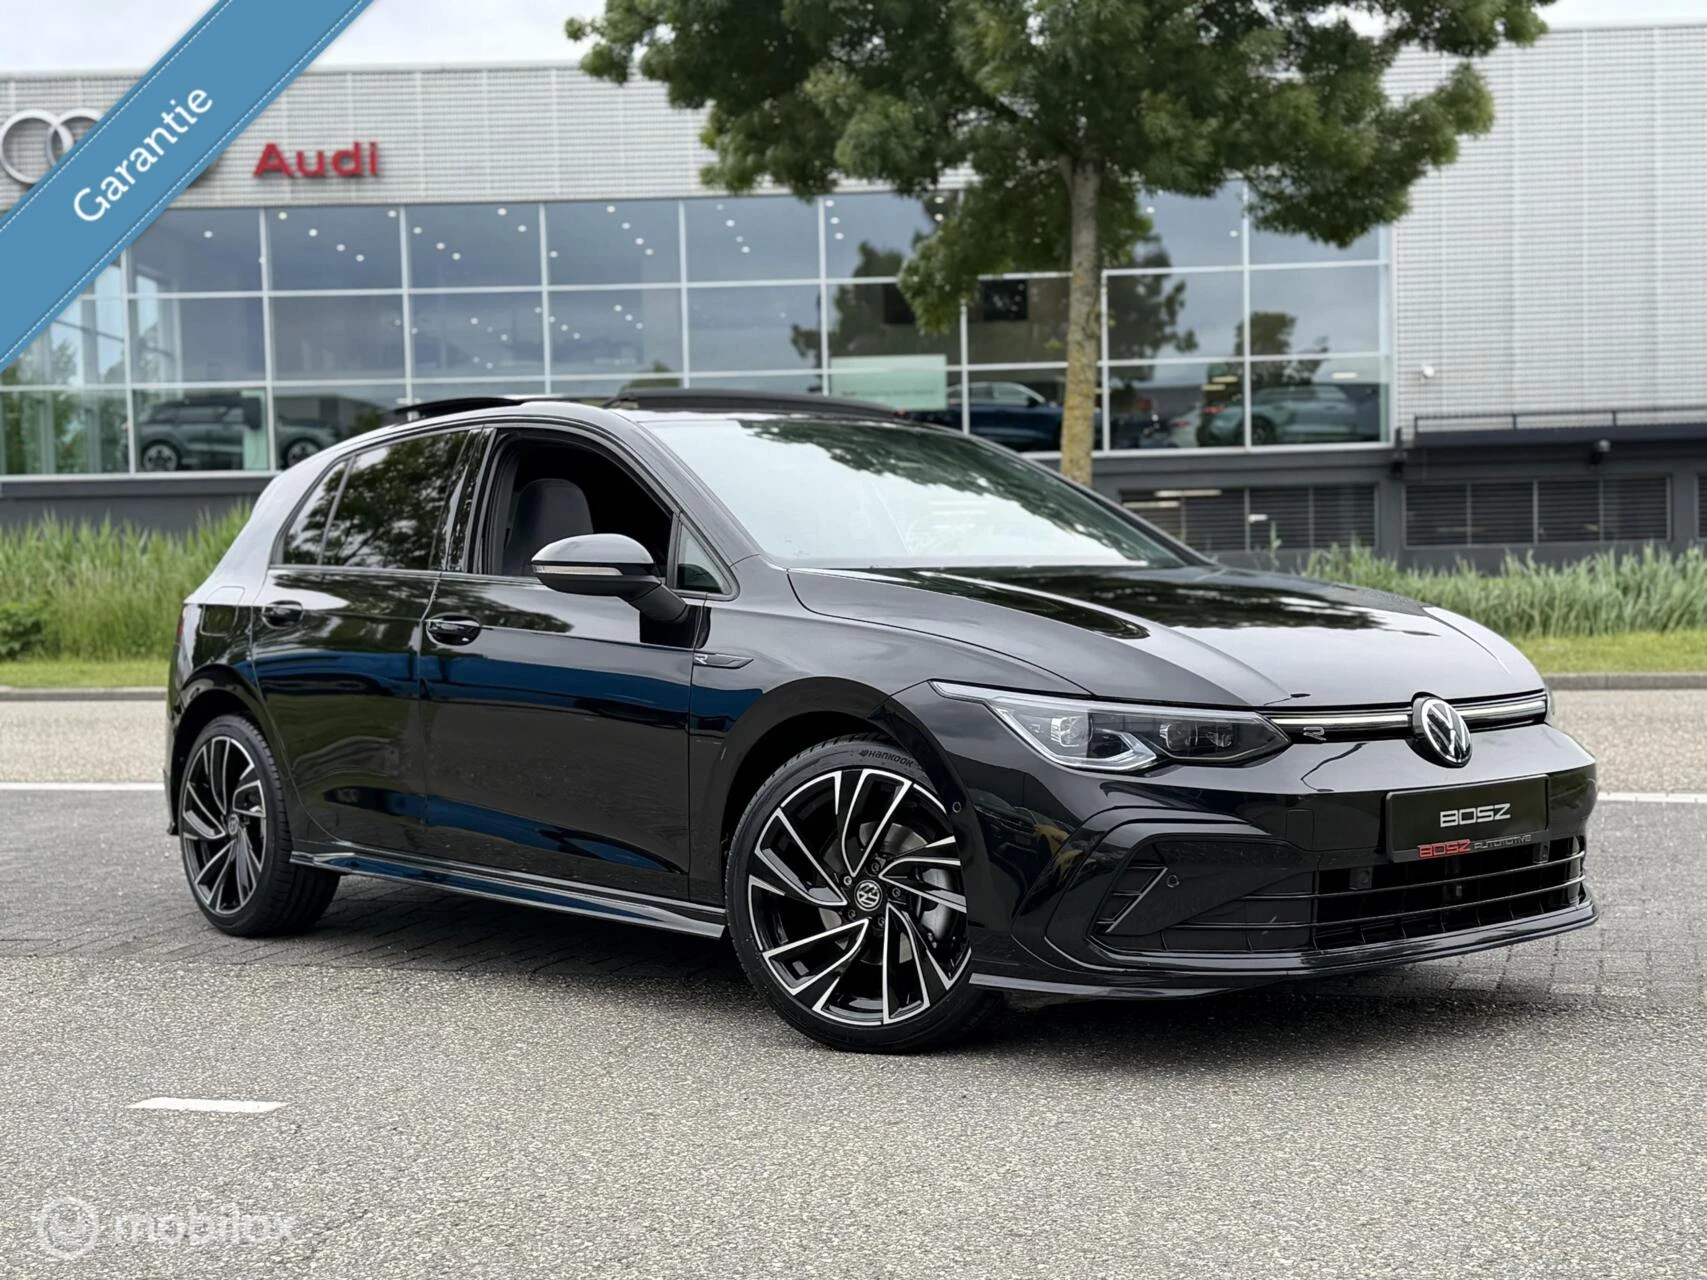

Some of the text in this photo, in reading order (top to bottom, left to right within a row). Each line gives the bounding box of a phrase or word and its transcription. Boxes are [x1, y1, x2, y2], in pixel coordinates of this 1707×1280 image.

[253, 141, 380, 178] Audi
[1439, 803, 1511, 828] BOSZ
[1417, 834, 1533, 859] BOSZ AUTOMOTIVE
